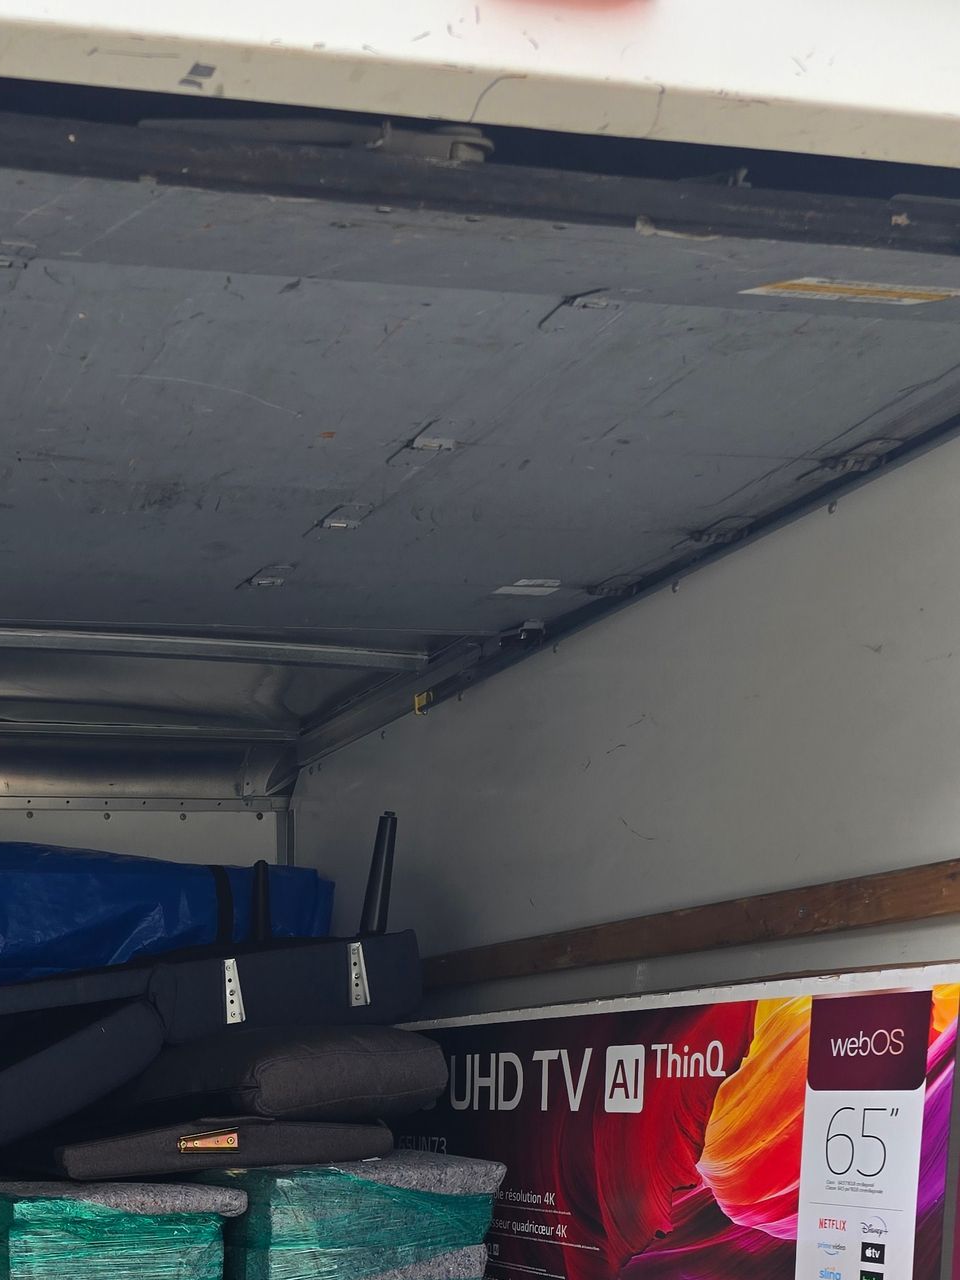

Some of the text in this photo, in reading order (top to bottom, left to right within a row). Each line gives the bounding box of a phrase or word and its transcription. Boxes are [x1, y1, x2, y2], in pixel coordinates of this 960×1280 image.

[830, 1028, 905, 1057] webOS
[450, 1040, 726, 1112] UHD TV AI ThinQ
[505, 1188, 542, 1205] résolution
[543, 1192, 556, 1206] 4K
[556, 1224, 568, 1239] 4K
[818, 1218, 846, 1231] NETFLIX
